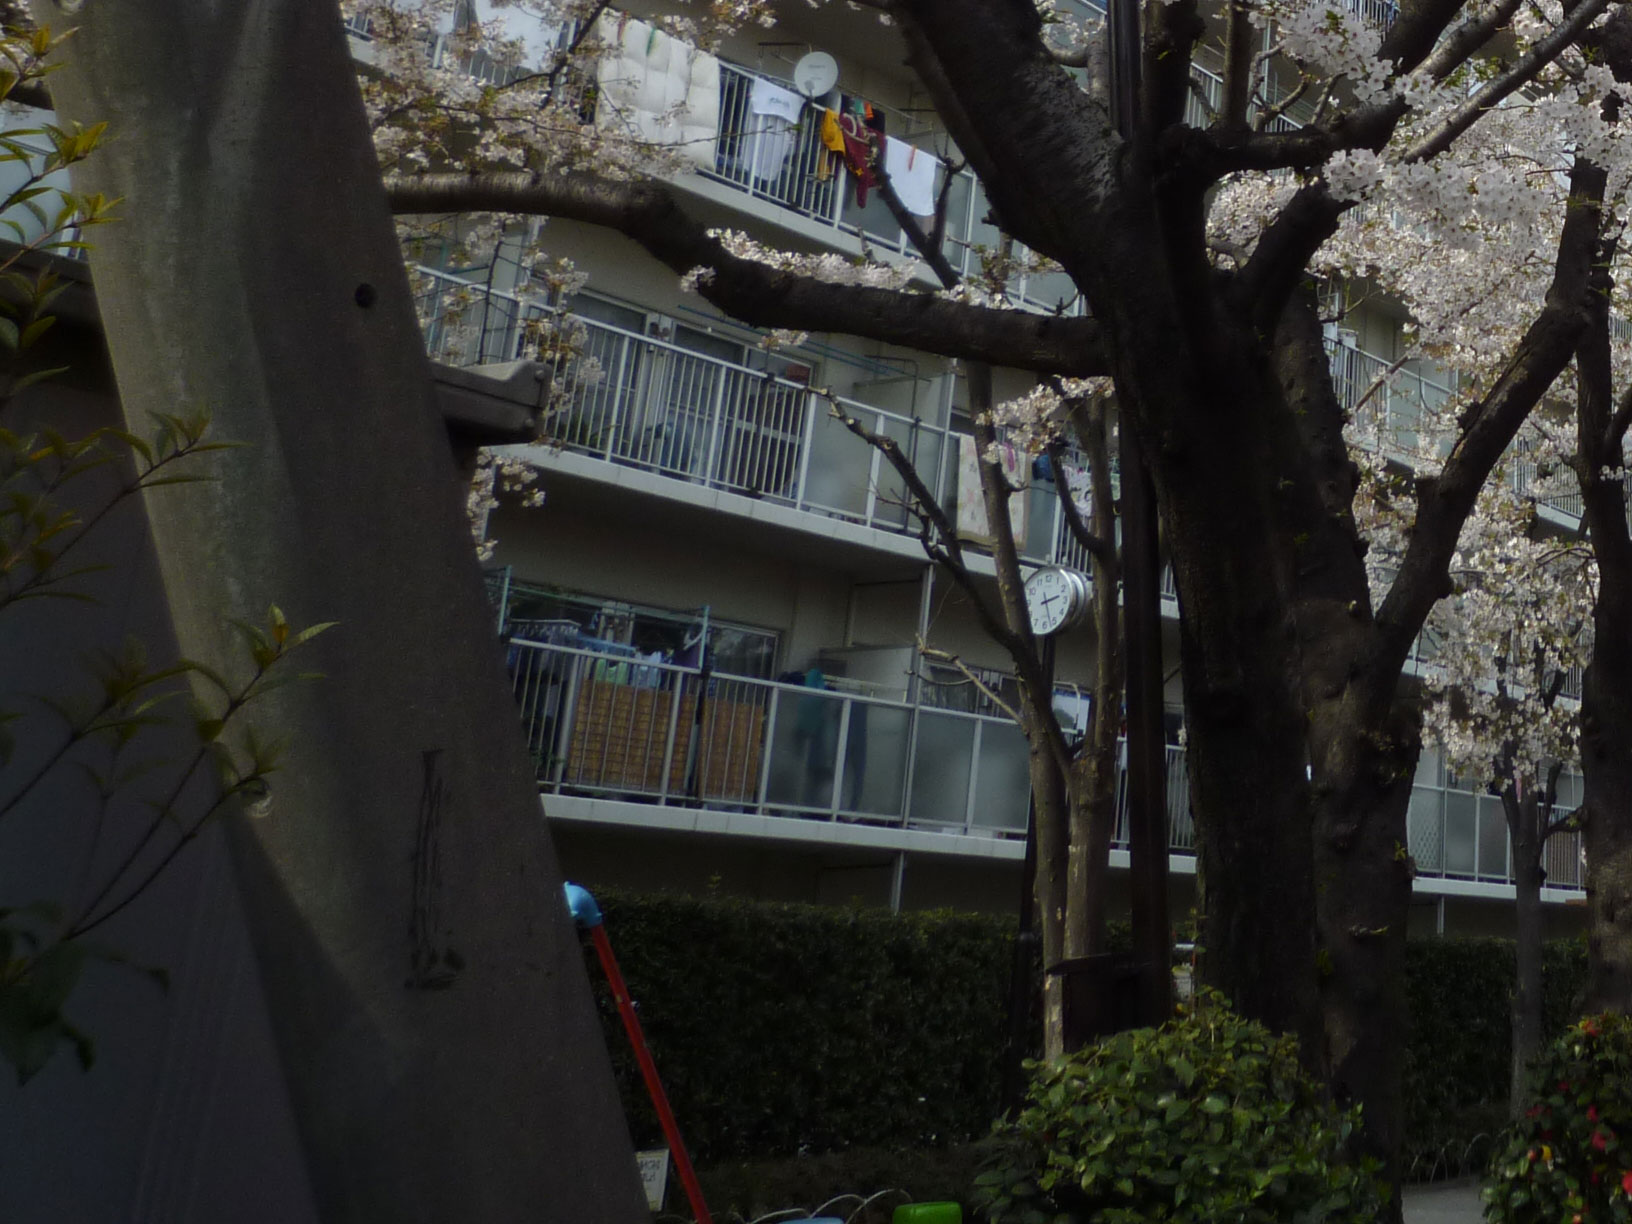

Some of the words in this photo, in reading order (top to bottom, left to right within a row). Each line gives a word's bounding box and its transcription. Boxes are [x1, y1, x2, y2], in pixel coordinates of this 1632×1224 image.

[1046, 574, 1052, 582] 12
[1037, 579, 1043, 587] 11
[1029, 587, 1036, 596] 10
